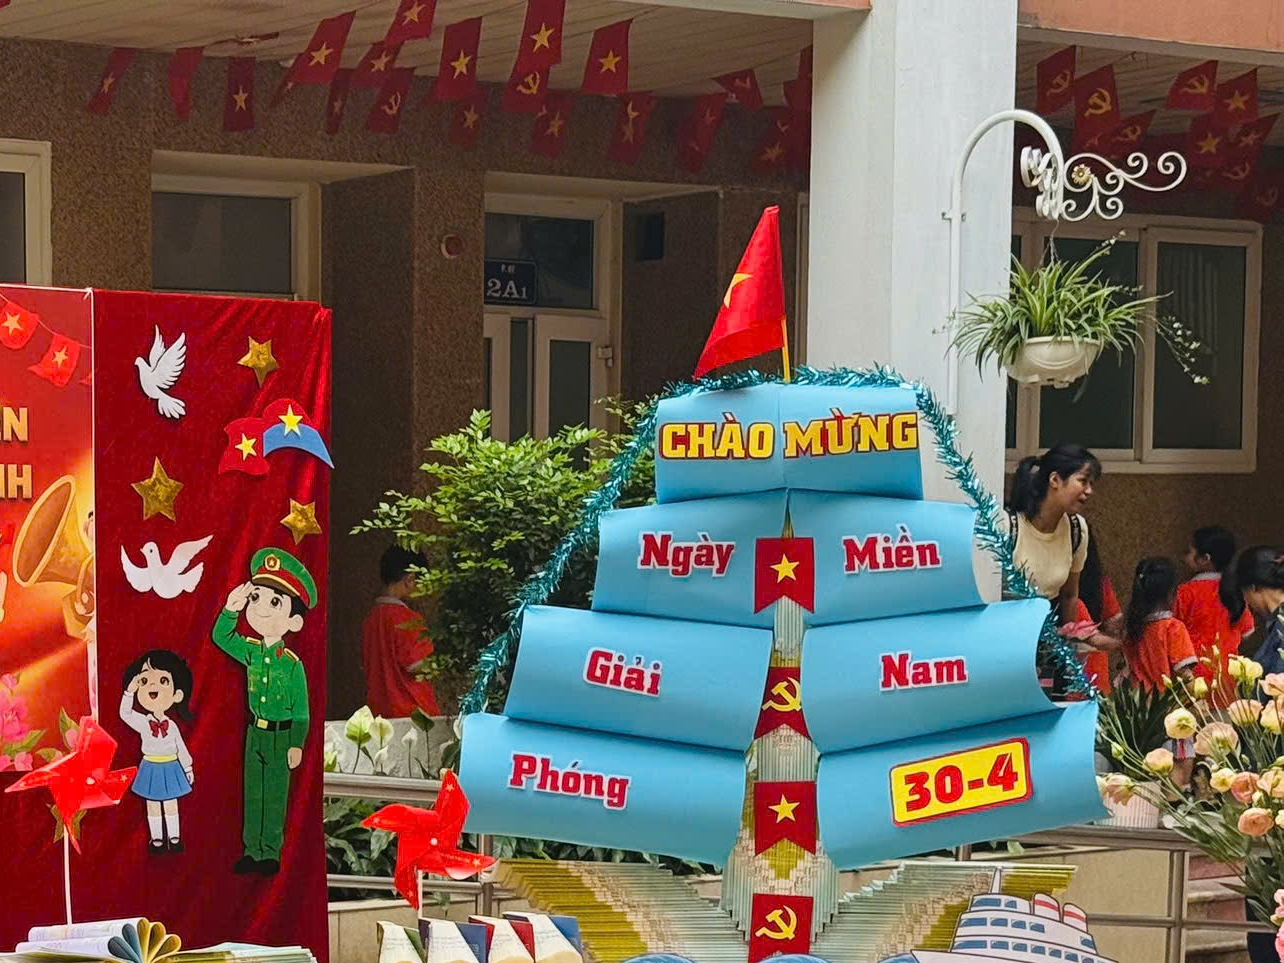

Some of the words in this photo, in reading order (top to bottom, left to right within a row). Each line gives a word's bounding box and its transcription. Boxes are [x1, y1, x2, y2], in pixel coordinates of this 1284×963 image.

[659, 411, 776, 461] CHÀO
[782, 408, 919, 460] MỪNG
[639, 533, 736, 577] Ngày
[842, 524, 941, 573] Miền
[585, 649, 661, 696] Giải
[881, 653, 967, 689] Nam
[509, 753, 630, 808] Phóng
[904, 752, 1019, 813] 30-4
